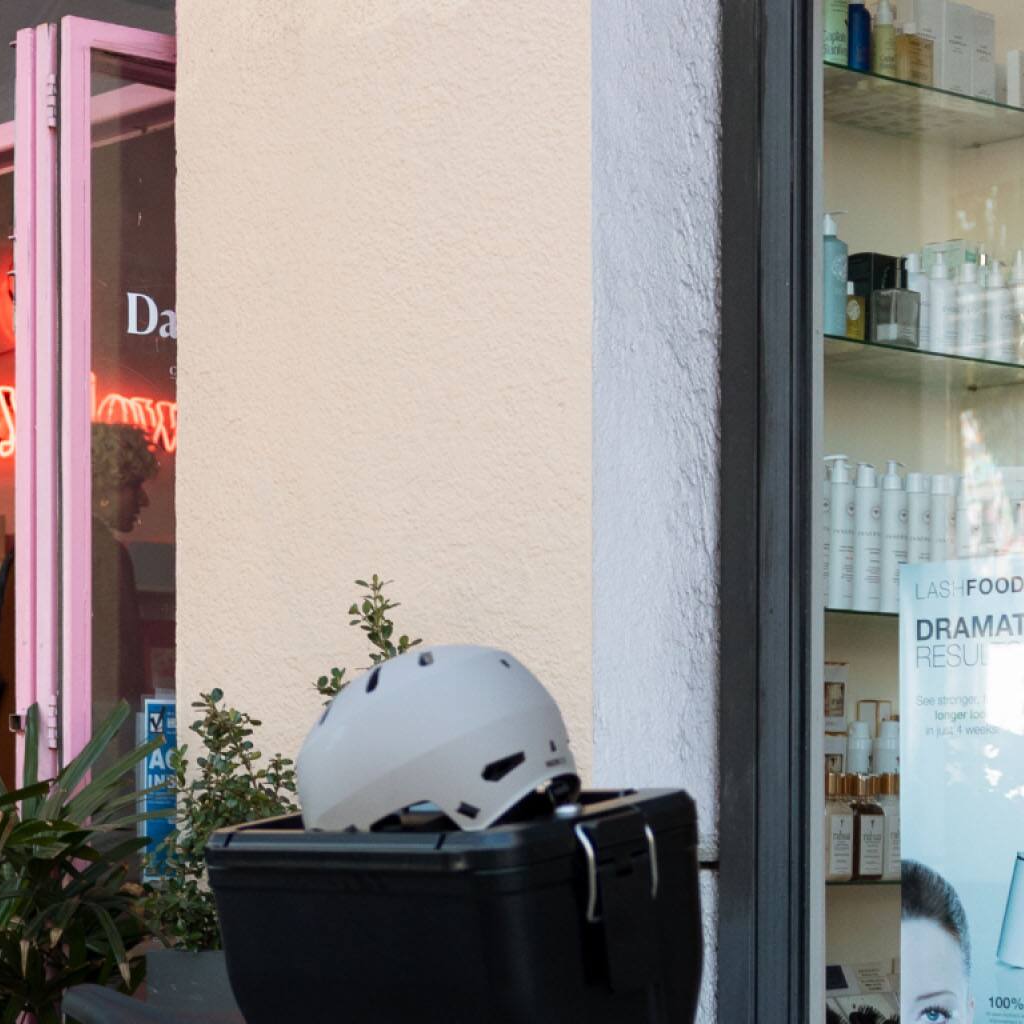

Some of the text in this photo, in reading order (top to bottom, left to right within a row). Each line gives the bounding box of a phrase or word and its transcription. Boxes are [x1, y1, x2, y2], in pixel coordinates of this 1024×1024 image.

[915, 576, 1024, 600] LASHFOOD
[916, 642, 988, 669] RESUL
[934, 710, 967, 722] longer
[988, 996, 1024, 1010] 100%
